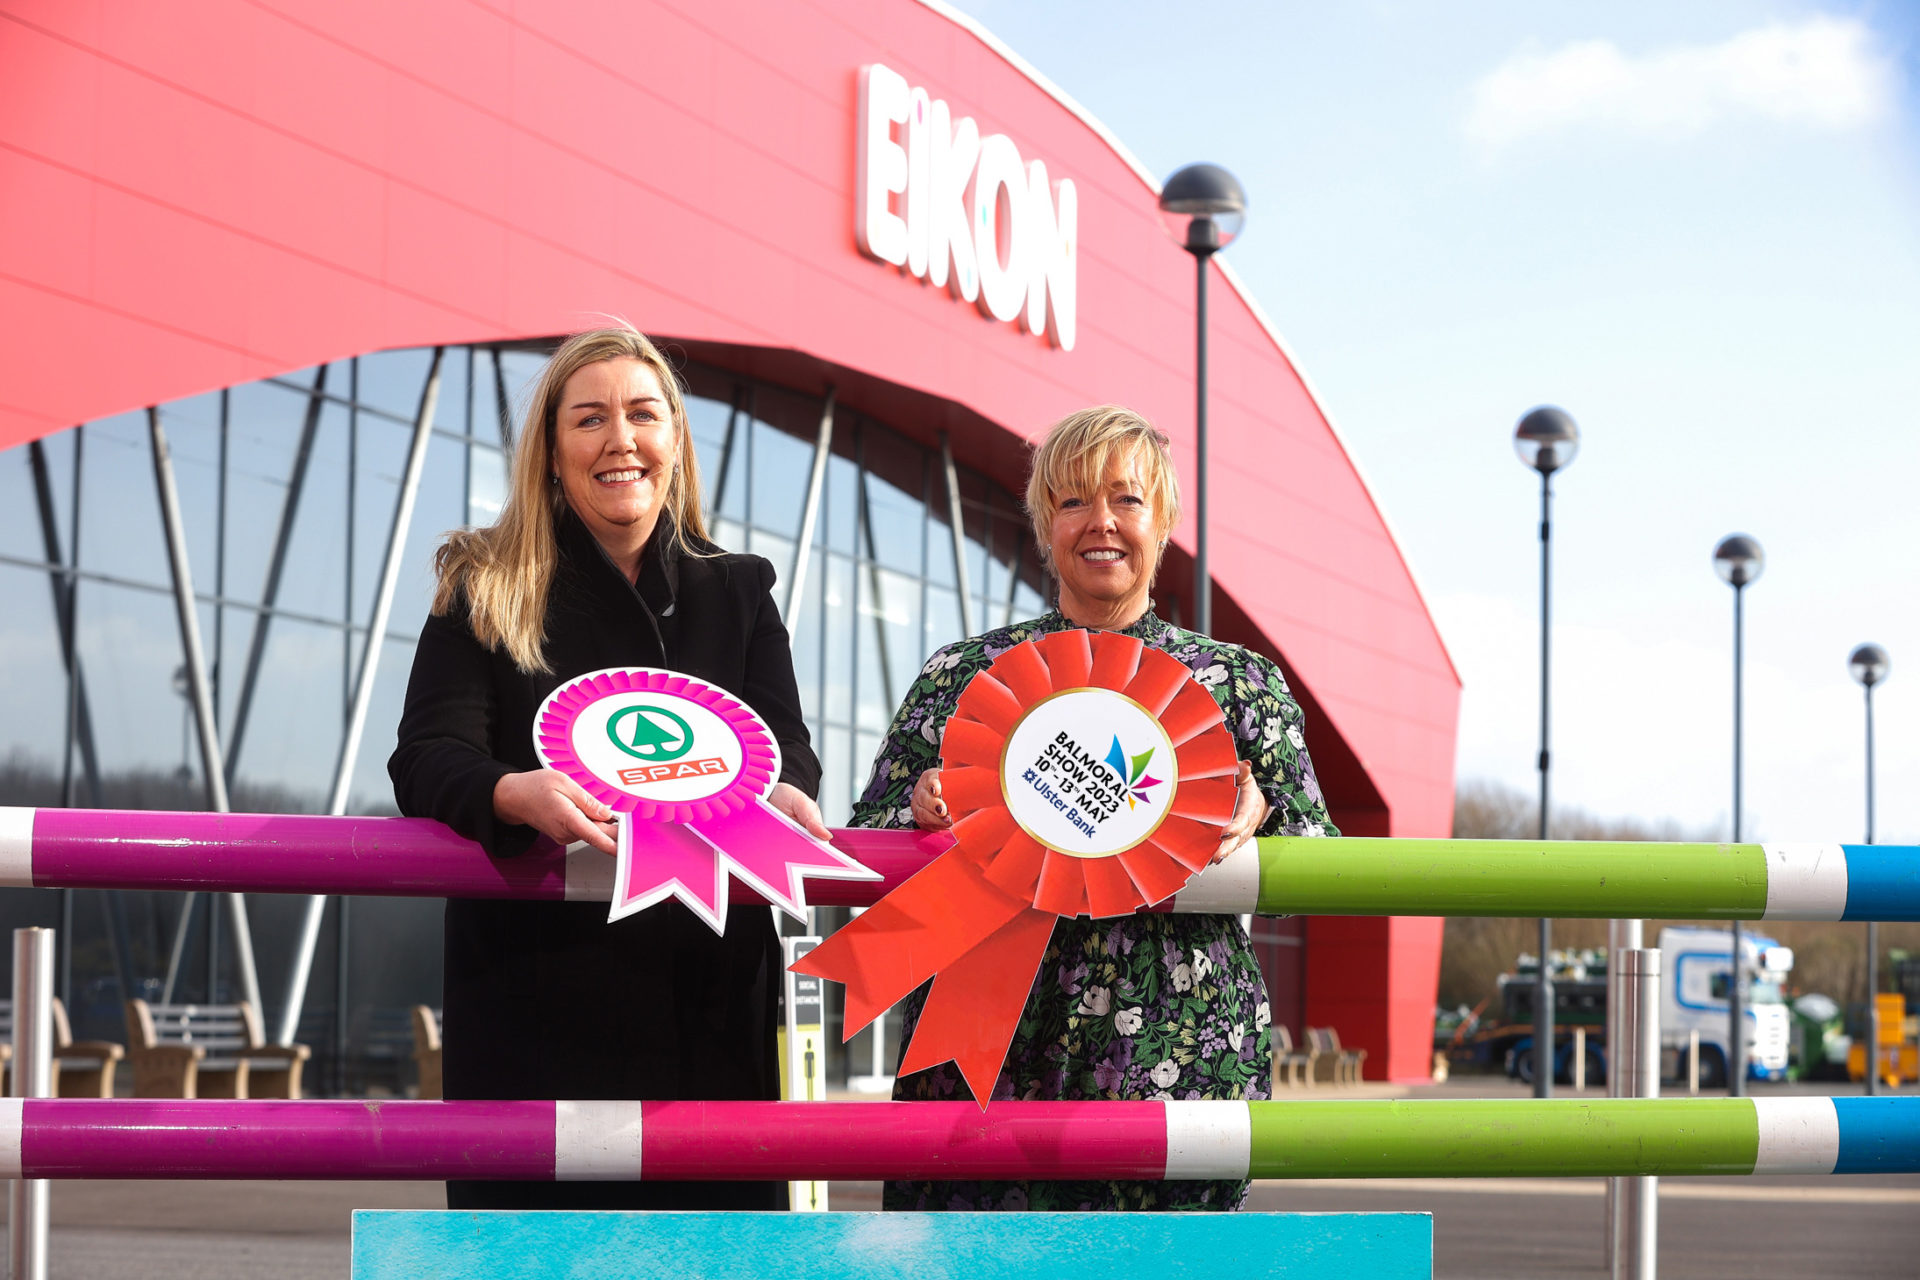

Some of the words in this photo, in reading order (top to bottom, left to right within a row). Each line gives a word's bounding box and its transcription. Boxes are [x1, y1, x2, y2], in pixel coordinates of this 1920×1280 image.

[862, 63, 1077, 352] EIKON
[623, 760, 724, 783] SPAR
[1044, 743, 1089, 783] SHOW
[1085, 781, 1119, 813] 2023
[1055, 731, 1128, 802] BALMORAL
[1033, 777, 1068, 812] Ulster
[1066, 807, 1096, 839] Bank
[1075, 794, 1110, 824] MAY
